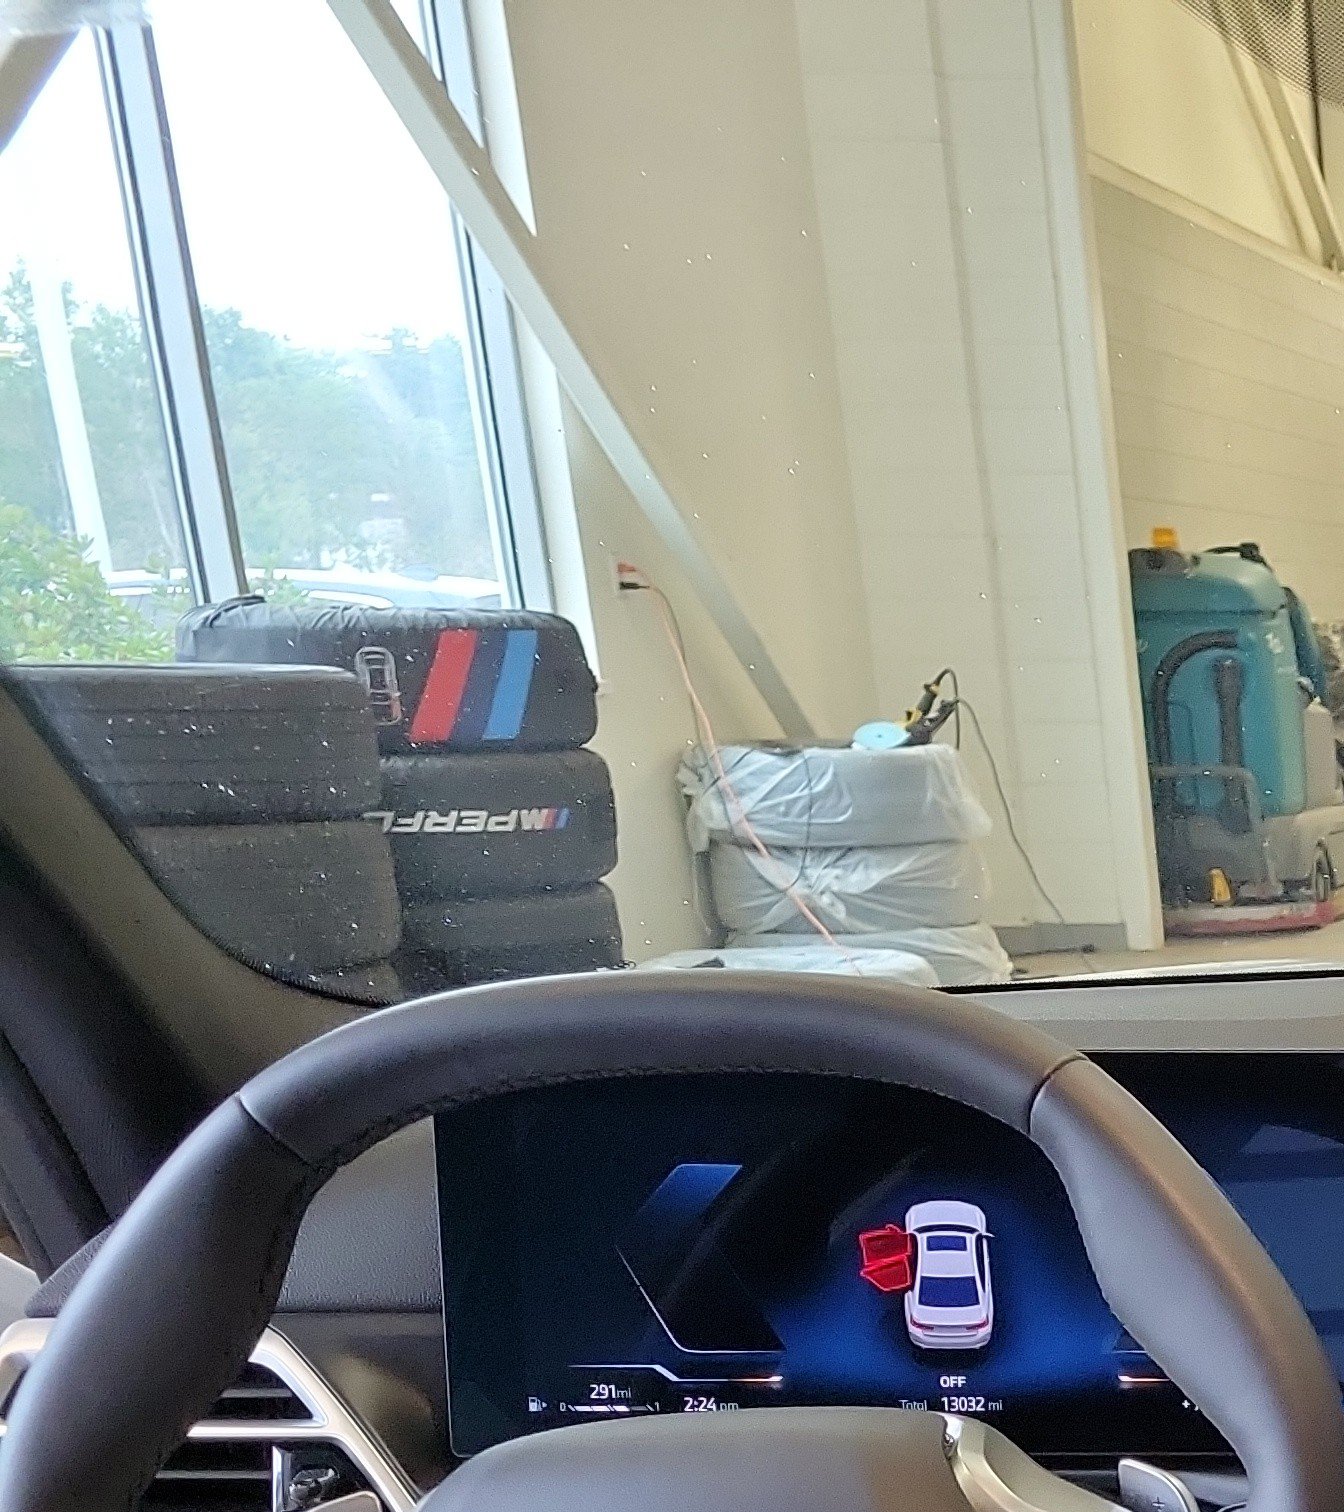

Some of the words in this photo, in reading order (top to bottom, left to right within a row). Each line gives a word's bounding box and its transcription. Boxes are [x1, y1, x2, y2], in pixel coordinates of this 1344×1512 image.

[940, 1376, 967, 1387] OFF
[683, 1397, 717, 1412] 2:24
[898, 1400, 928, 1411] Total
[941, 1396, 985, 1412] 13032
